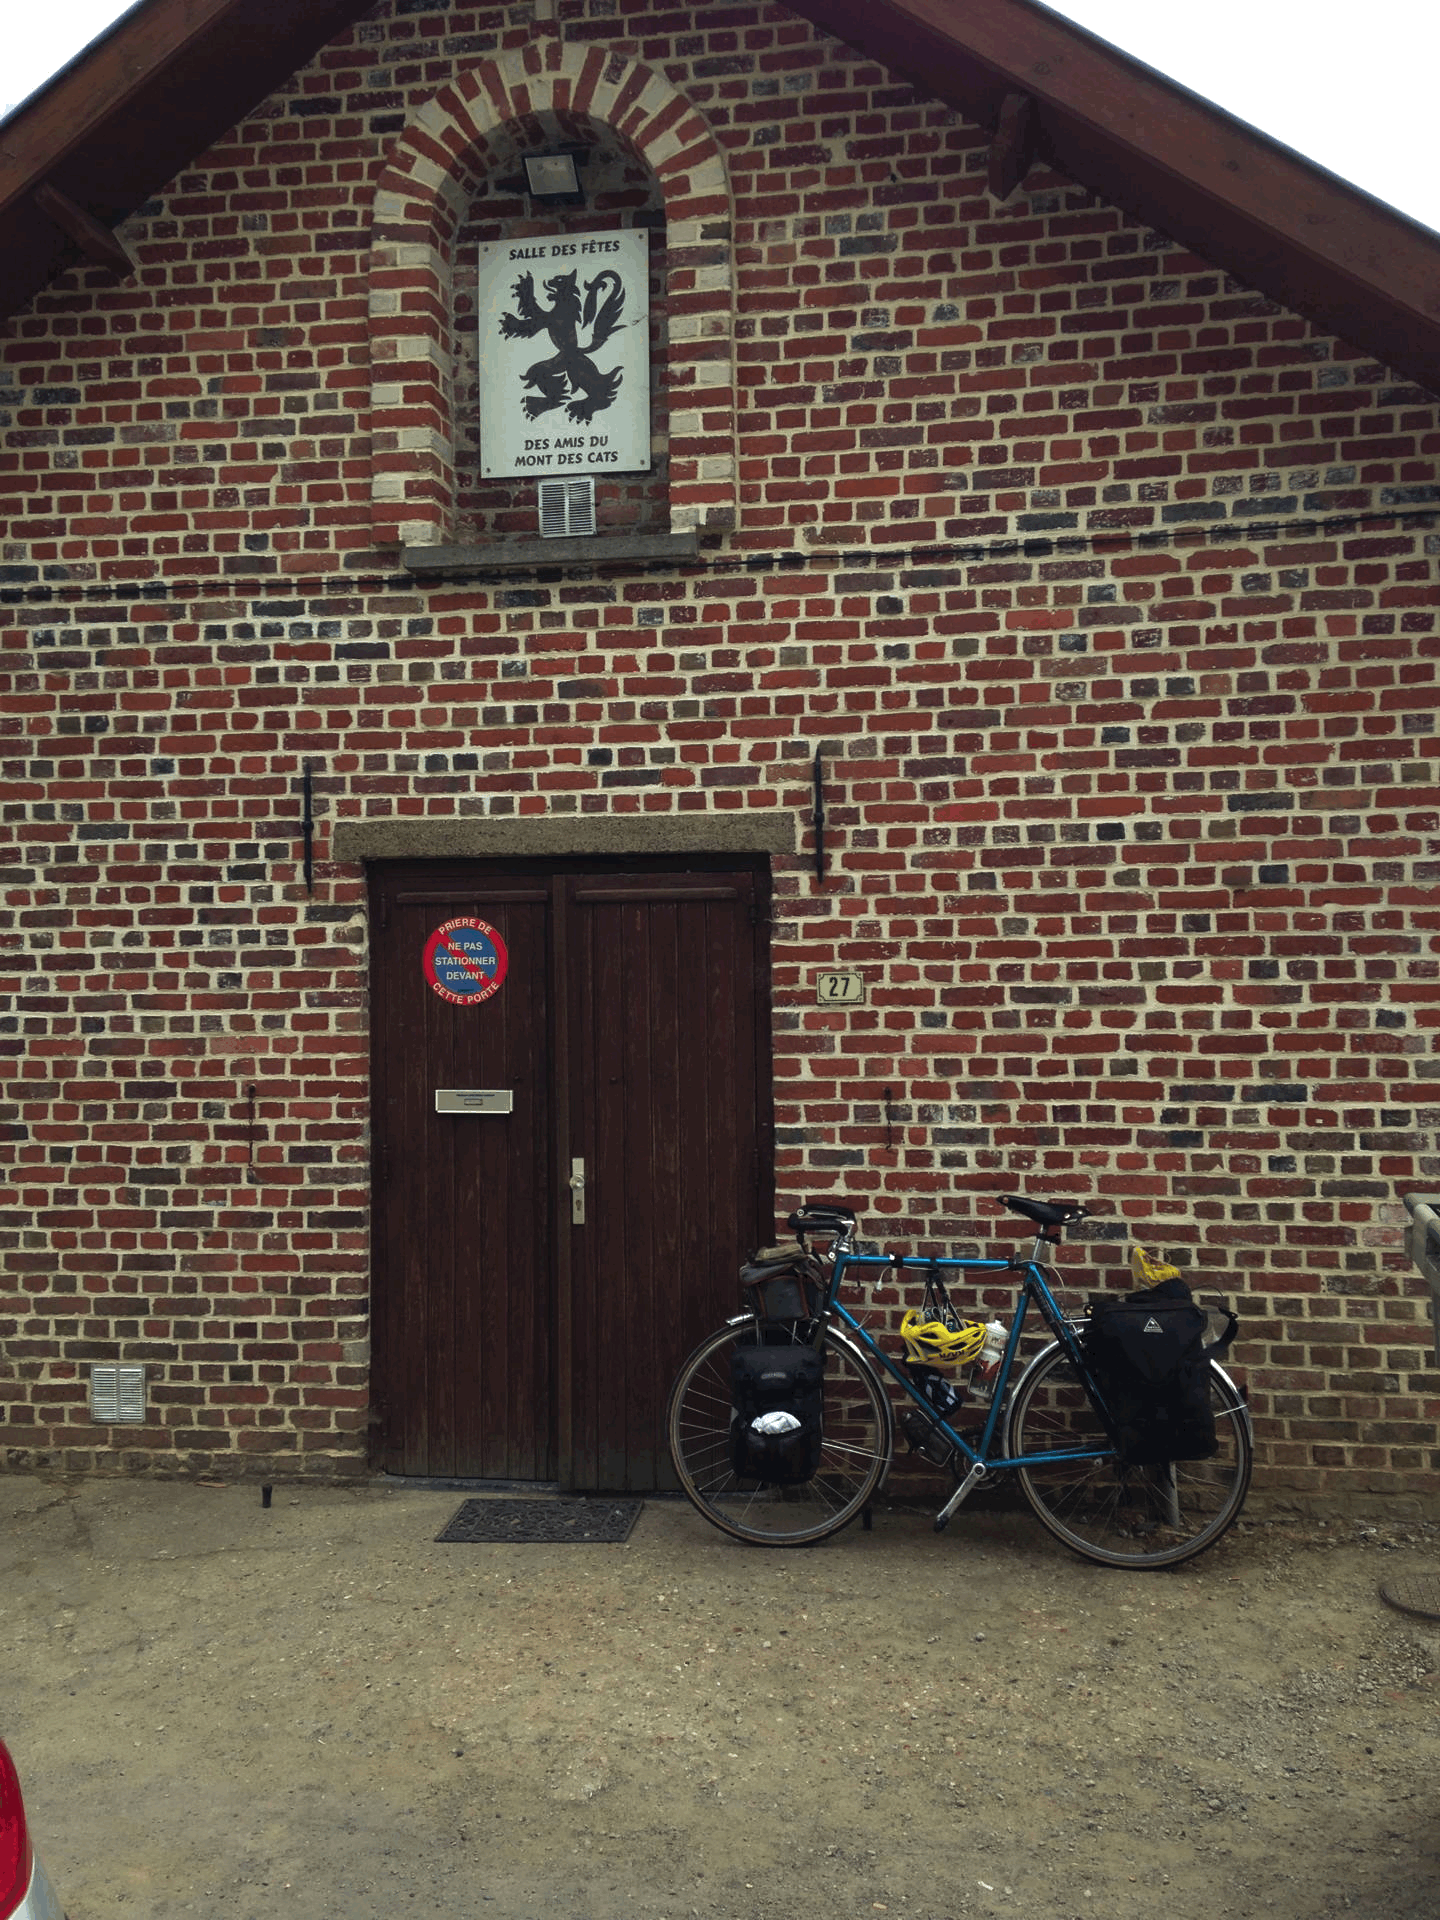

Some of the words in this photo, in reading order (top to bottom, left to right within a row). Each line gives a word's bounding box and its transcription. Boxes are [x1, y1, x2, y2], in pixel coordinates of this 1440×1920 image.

[509, 246, 546, 260] SALLE
[551, 244, 577, 257] DES
[581, 239, 620, 254] FÊTES
[524, 439, 550, 450] DES
[554, 437, 585, 448] AMIS
[590, 436, 609, 447] DU
[515, 455, 553, 467] MONT
[557, 453, 583, 464] DES
[587, 451, 618, 463] CATS
[438, 918, 476, 935] PRIERE
[477, 921, 492, 935] DE
[448, 942, 461, 950] NE
[464, 942, 483, 950] PAS
[435, 957, 495, 965] STATIONNER
[446, 972, 484, 980] DEVANT
[433, 982, 463, 1004] CETTE
[467, 981, 500, 1004] PORTE
[829, 977, 849, 996] 27
